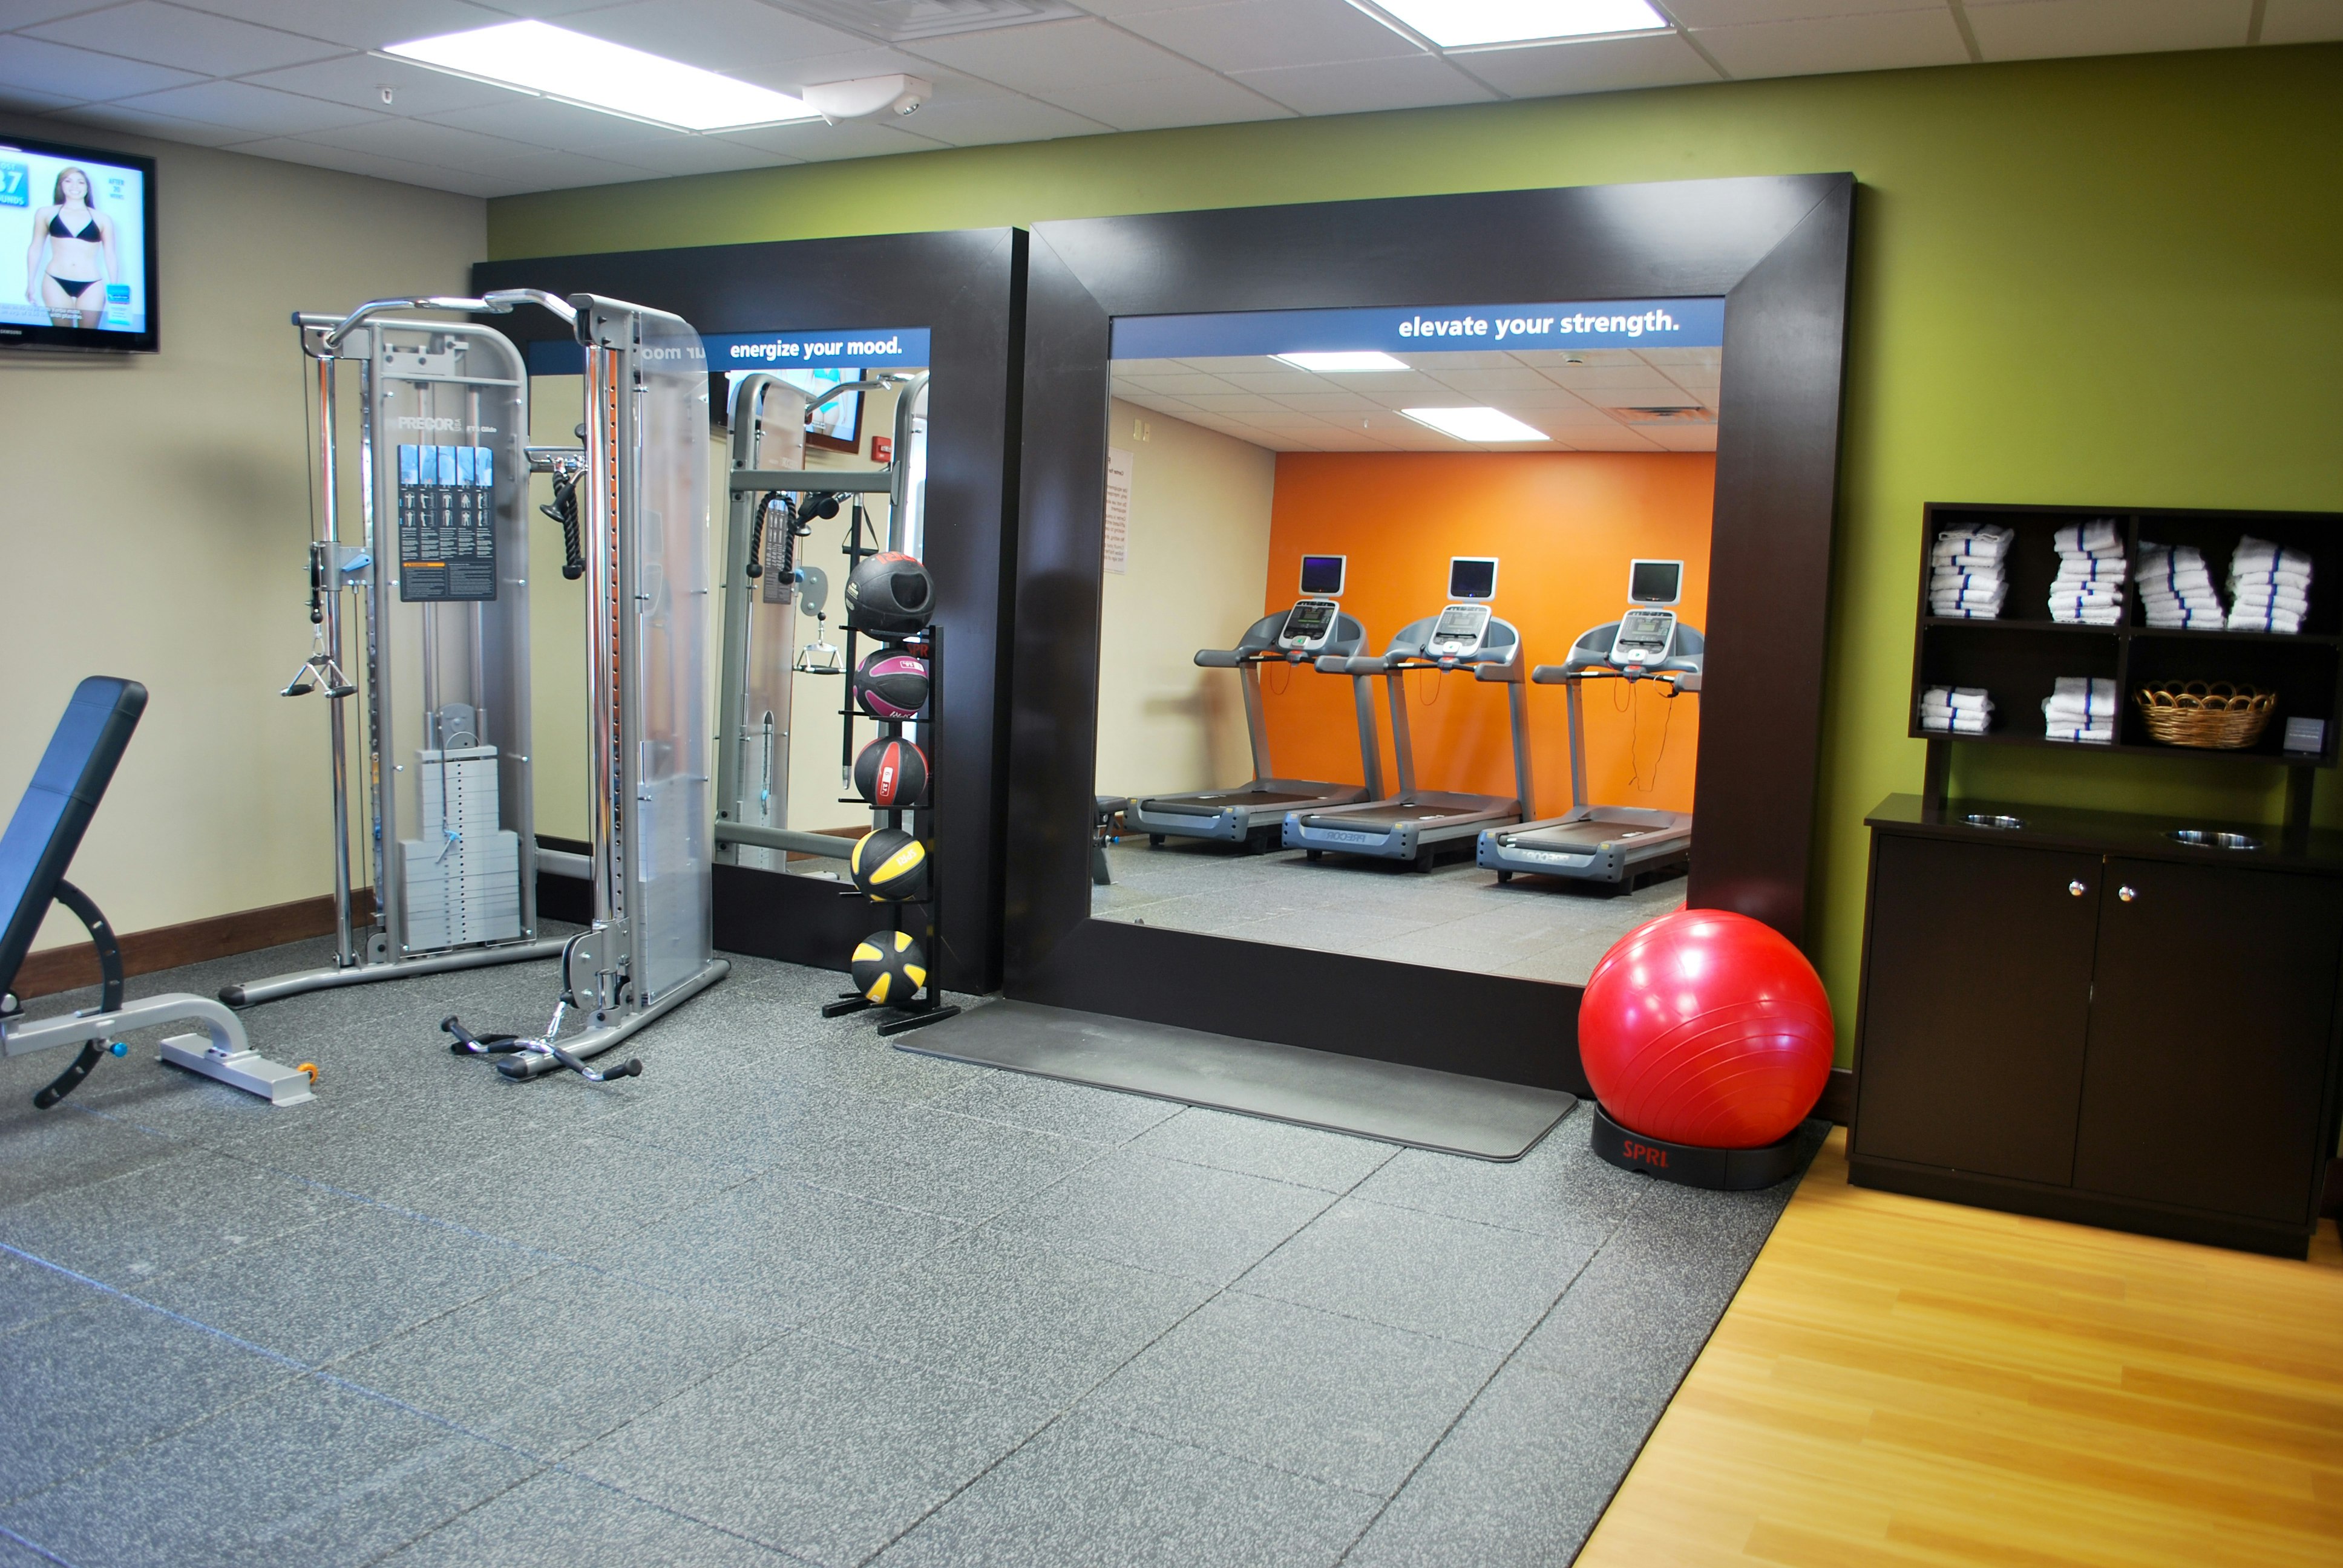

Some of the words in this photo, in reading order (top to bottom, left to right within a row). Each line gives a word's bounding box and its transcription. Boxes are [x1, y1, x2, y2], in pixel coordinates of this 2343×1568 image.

[0, 194, 24, 205] UNDS
[1398, 315, 1488, 338] elevate
[1495, 316, 1553, 341] your
[1559, 309, 1680, 338] strength.
[730, 339, 799, 362] energize
[804, 342, 843, 361] your
[847, 336, 902, 356] mood.
[398, 416, 454, 431] PRECOR
[906, 642, 930, 658] SPR
[896, 848, 917, 866] SPRI
[1623, 1140, 1666, 1168] SPRI
